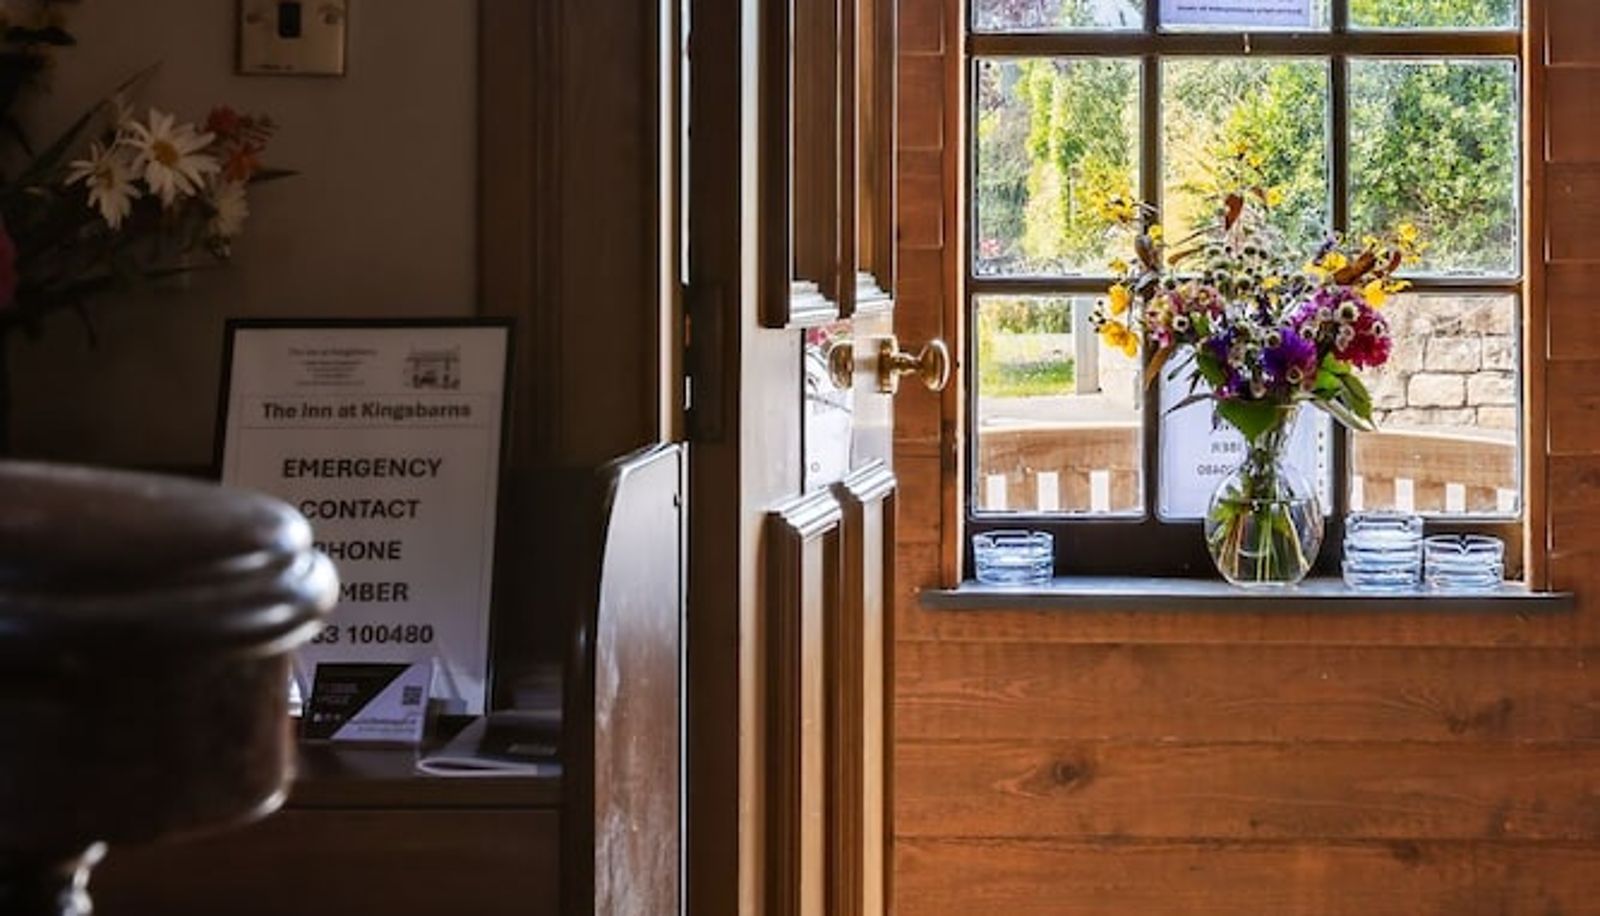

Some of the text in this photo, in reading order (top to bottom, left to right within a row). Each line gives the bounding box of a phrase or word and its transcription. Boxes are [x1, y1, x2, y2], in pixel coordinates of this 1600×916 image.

[263, 401, 472, 421] The Inn at Kingsbarns
[282, 457, 442, 479] EMERGENCY
[300, 498, 421, 520] CONTACT
[337, 581, 409, 603] MBER
[347, 624, 434, 644] 100480
